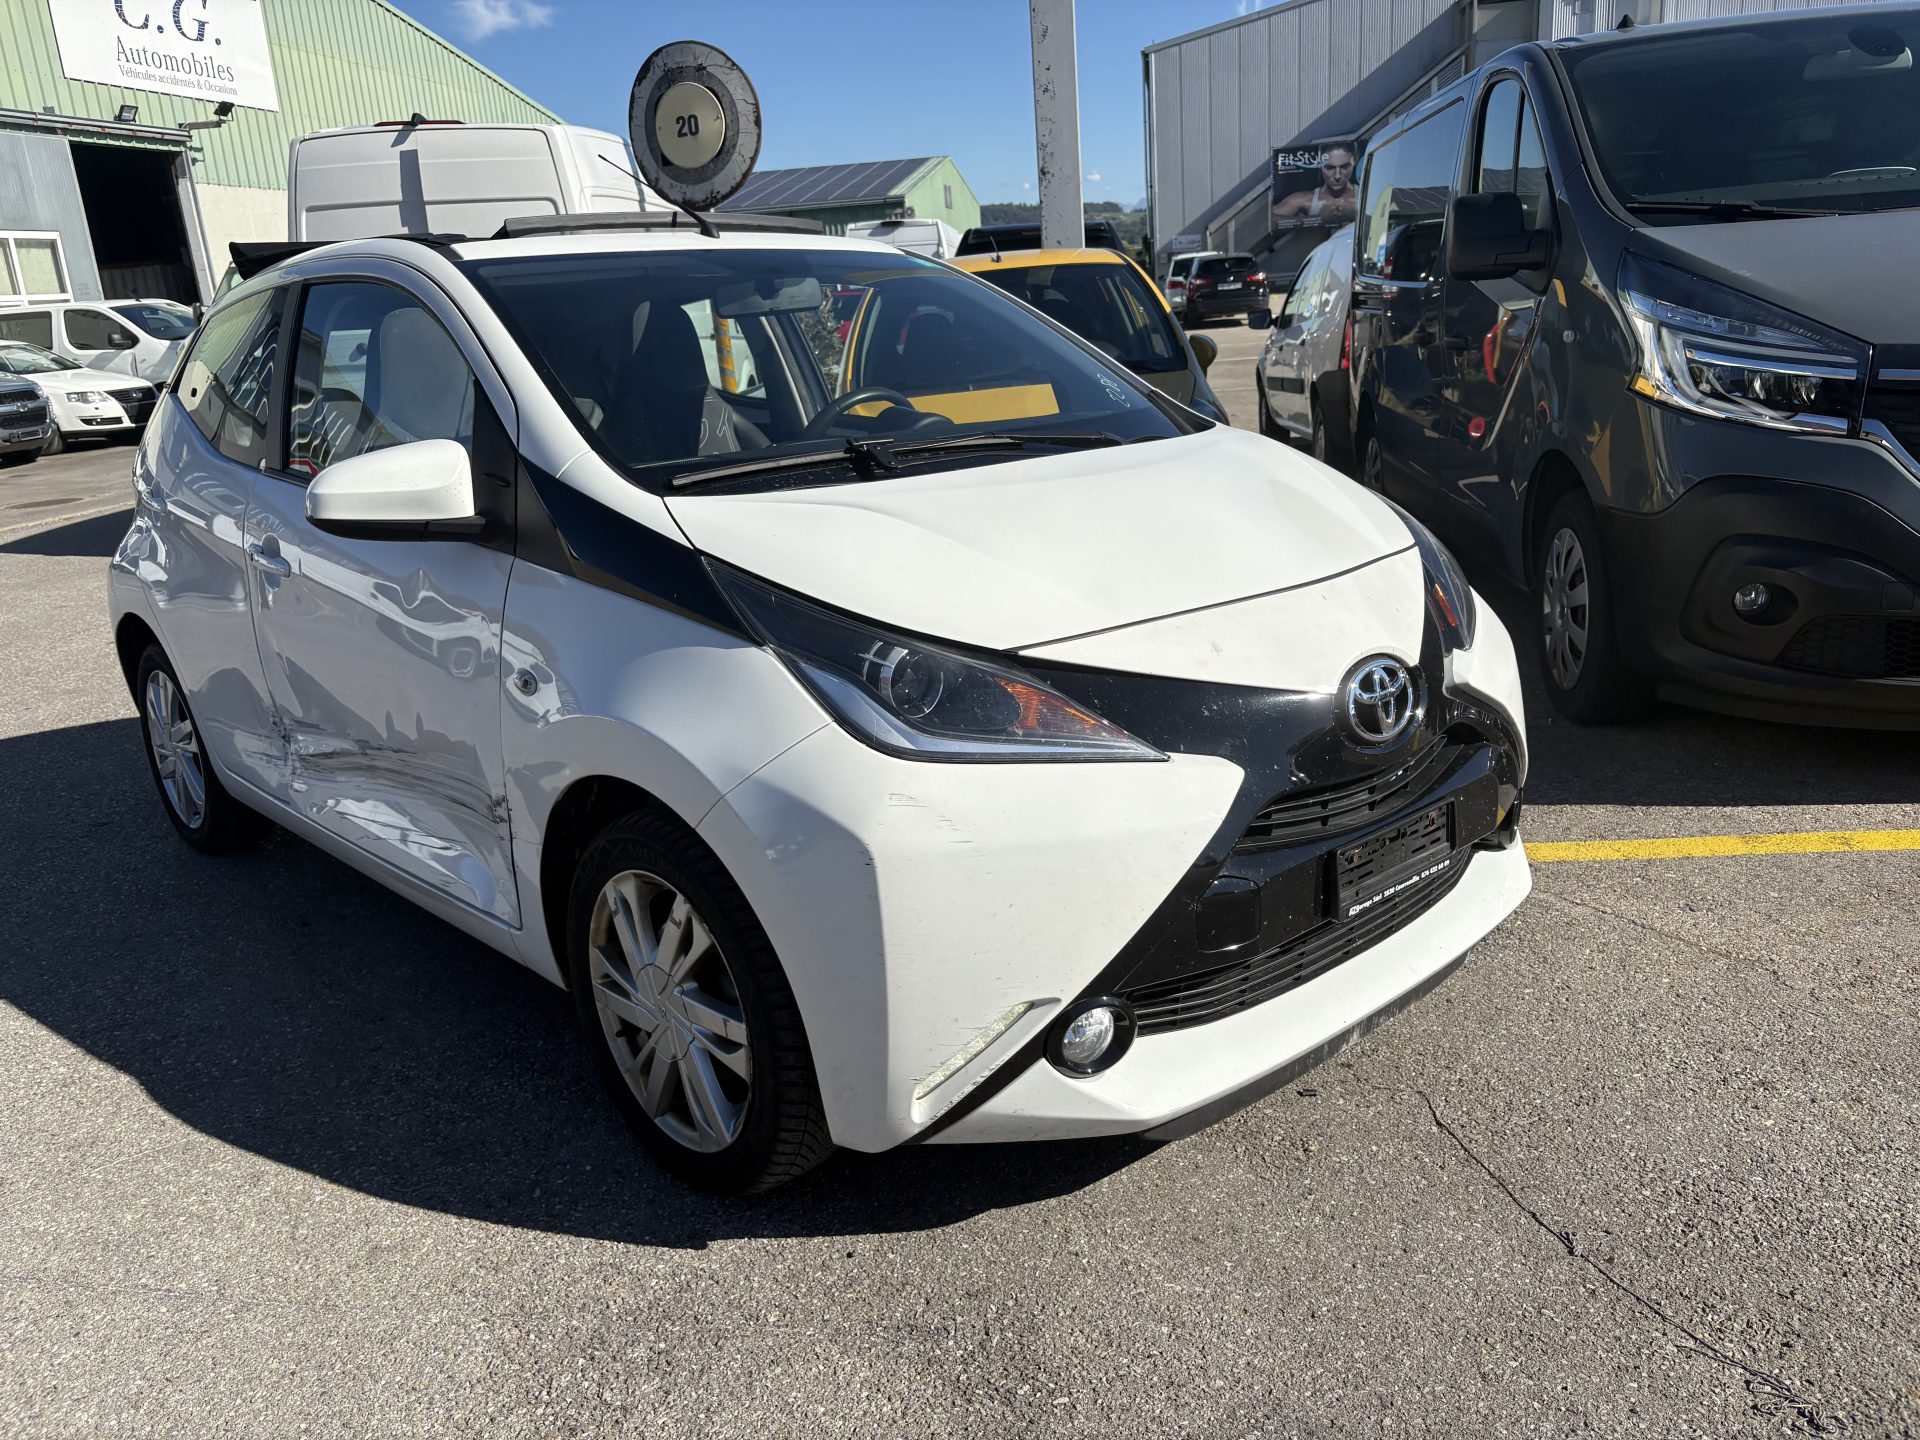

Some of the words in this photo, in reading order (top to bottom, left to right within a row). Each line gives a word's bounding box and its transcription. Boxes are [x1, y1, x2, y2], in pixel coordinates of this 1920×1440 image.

[113, 0, 222, 46] C.G.
[116, 35, 235, 83] Automobiles
[118, 64, 157, 82] Véhicules
[158, 74, 196, 89] accidentés
[197, 80, 204, 90] &
[204, 79, 238, 96] Occasions
[675, 114, 700, 138] 20
